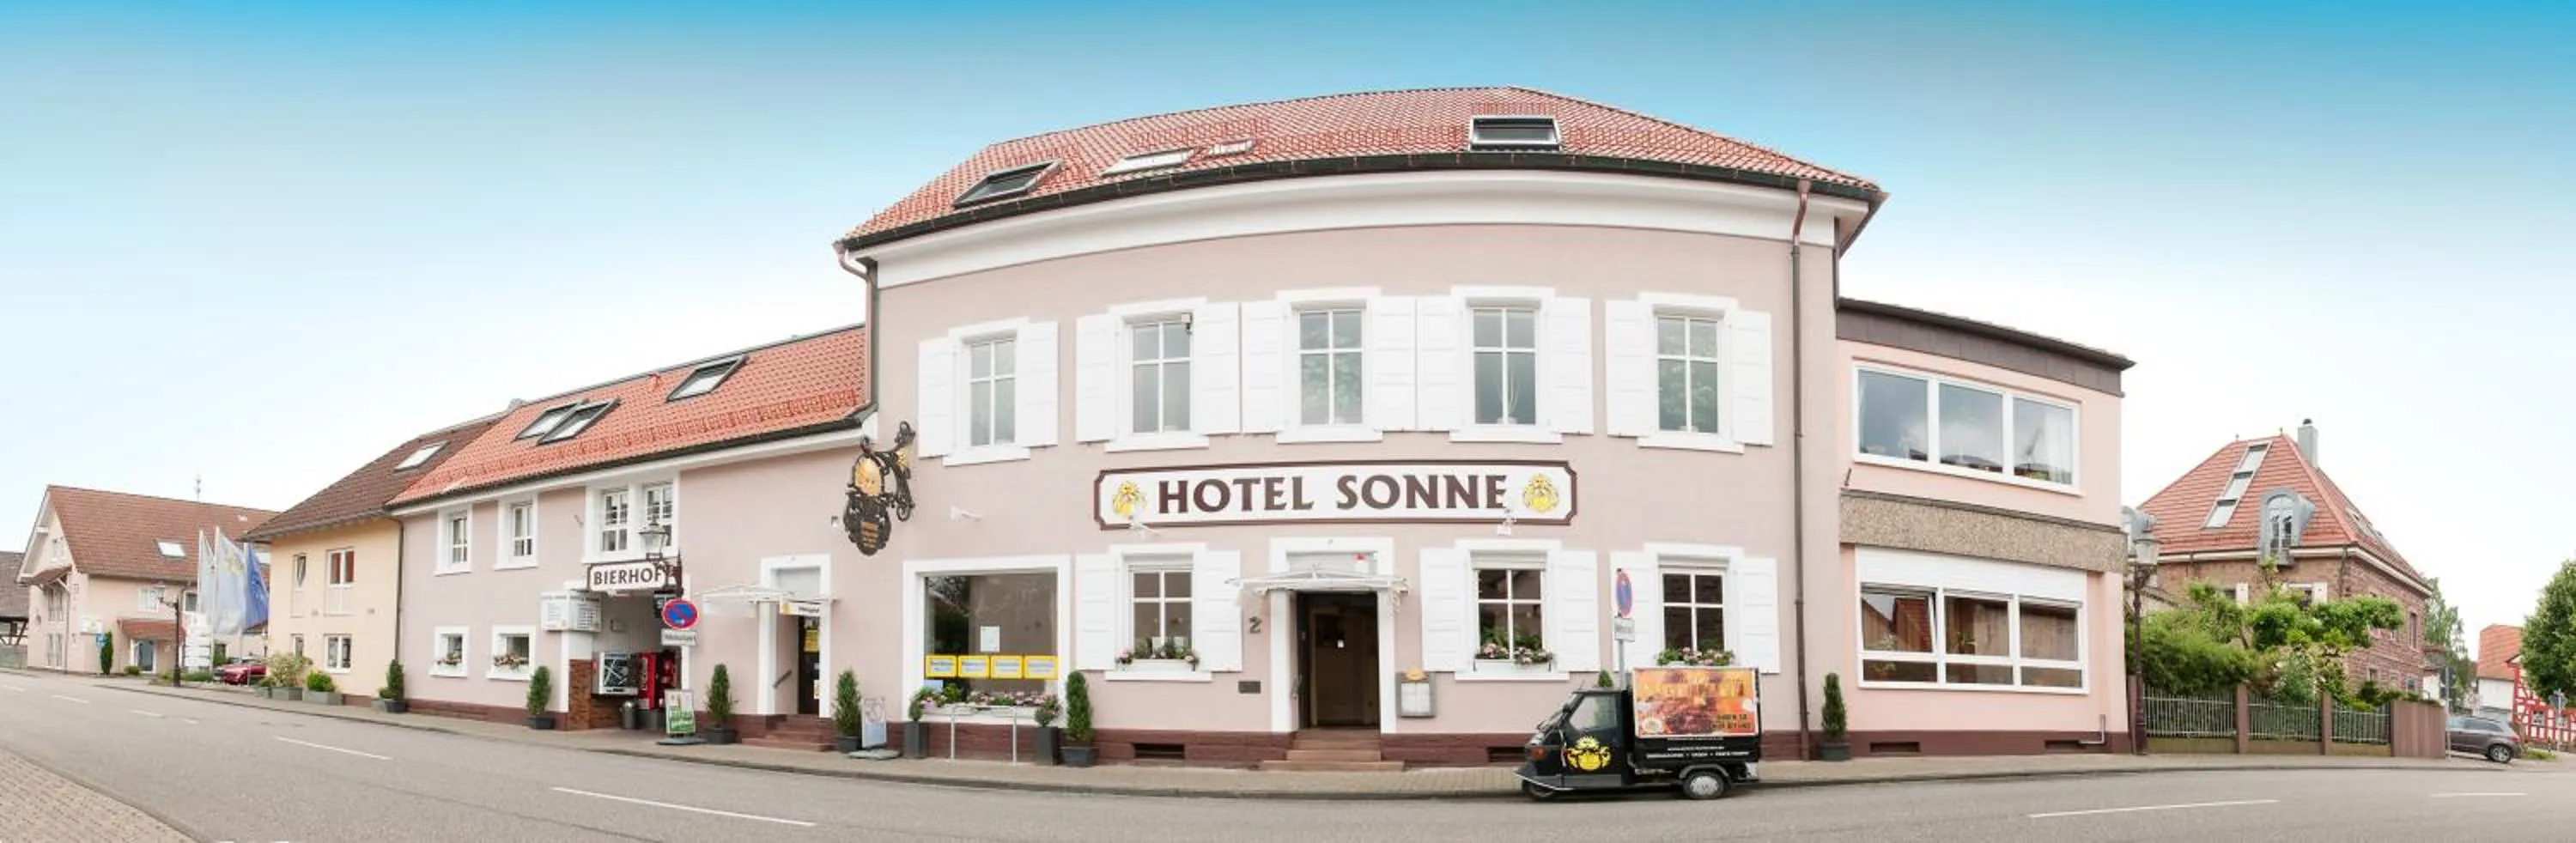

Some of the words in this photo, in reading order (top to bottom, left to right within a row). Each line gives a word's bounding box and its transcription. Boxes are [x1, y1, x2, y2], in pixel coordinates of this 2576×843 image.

[1157, 477, 1315, 514] HOTEL
[1336, 474, 1508, 509] SONNE
[593, 567, 664, 585] BIERHOF
[1249, 616, 1263, 634] 2
